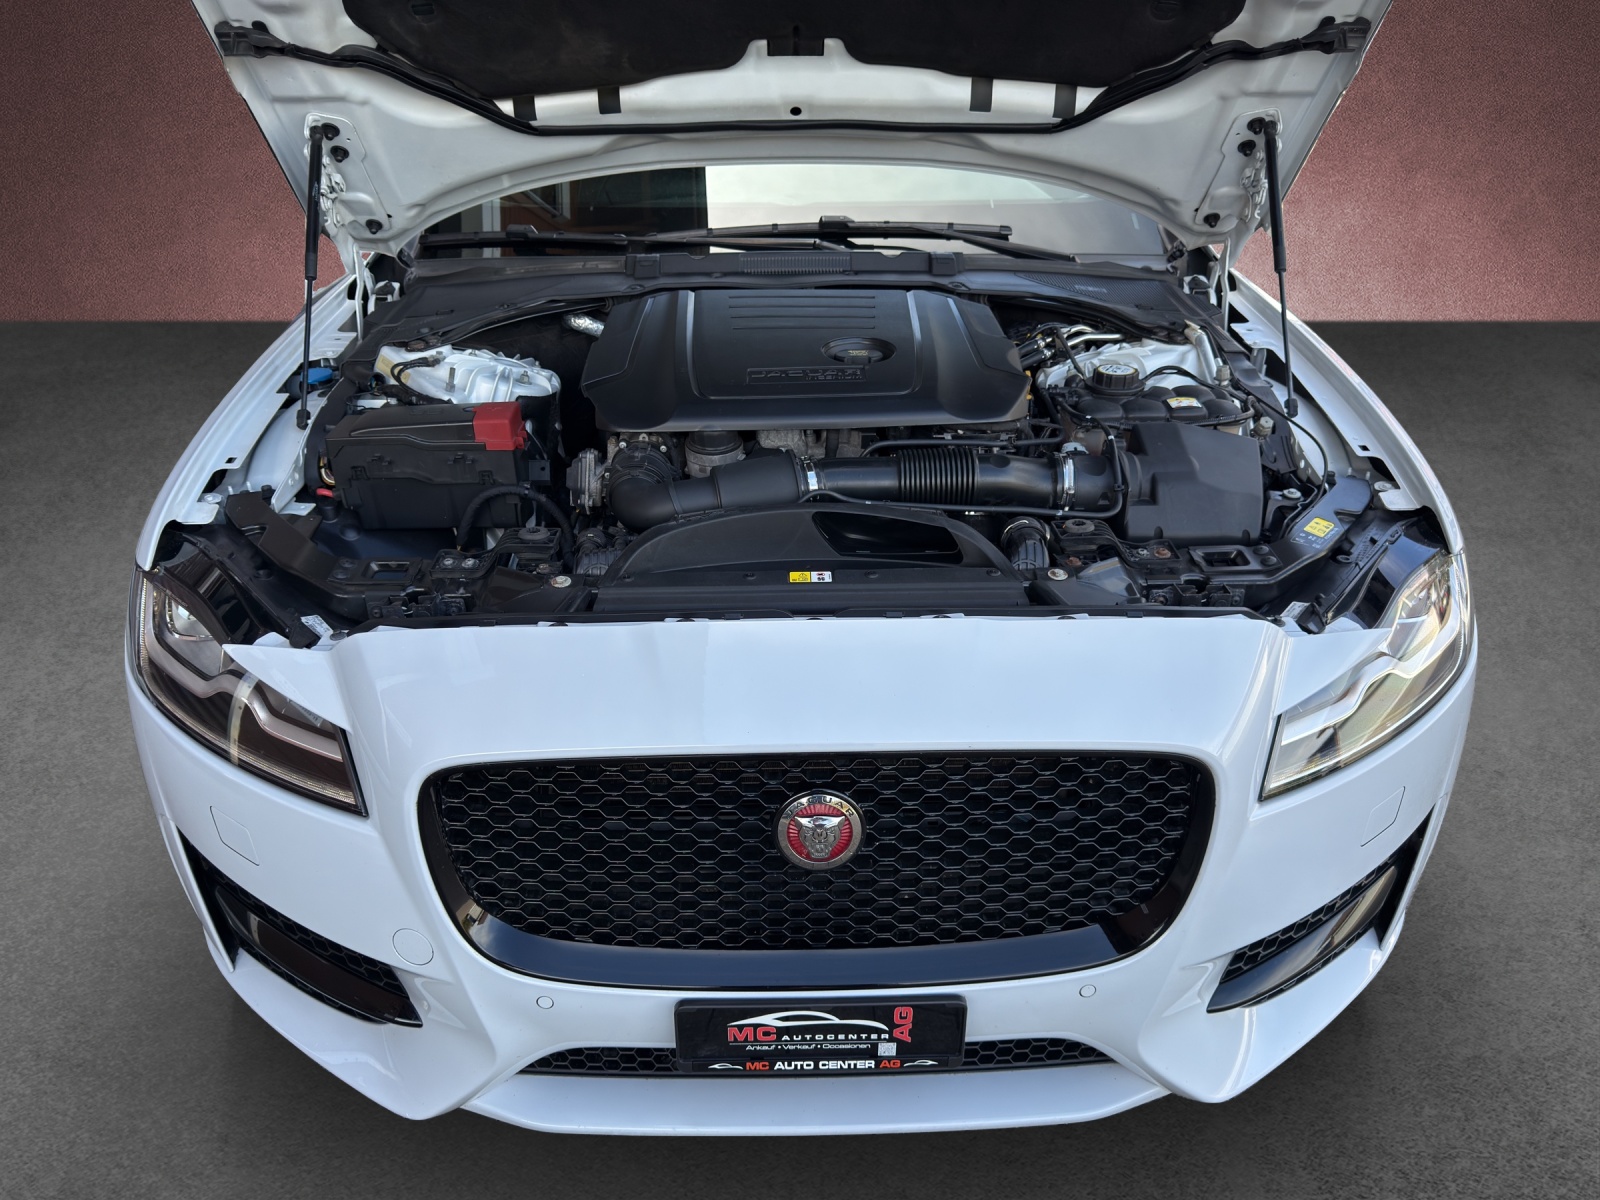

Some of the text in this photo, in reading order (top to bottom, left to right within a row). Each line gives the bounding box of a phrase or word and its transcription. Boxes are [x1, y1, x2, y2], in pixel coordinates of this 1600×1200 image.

[782, 796, 854, 819] JAGUAR
[892, 1006, 914, 1043] AG
[727, 1026, 889, 1042] MC AUTOCENTER
[745, 1043, 776, 1051] Ankauf
[745, 1059, 901, 1071] MC AUTO CENTER AG
